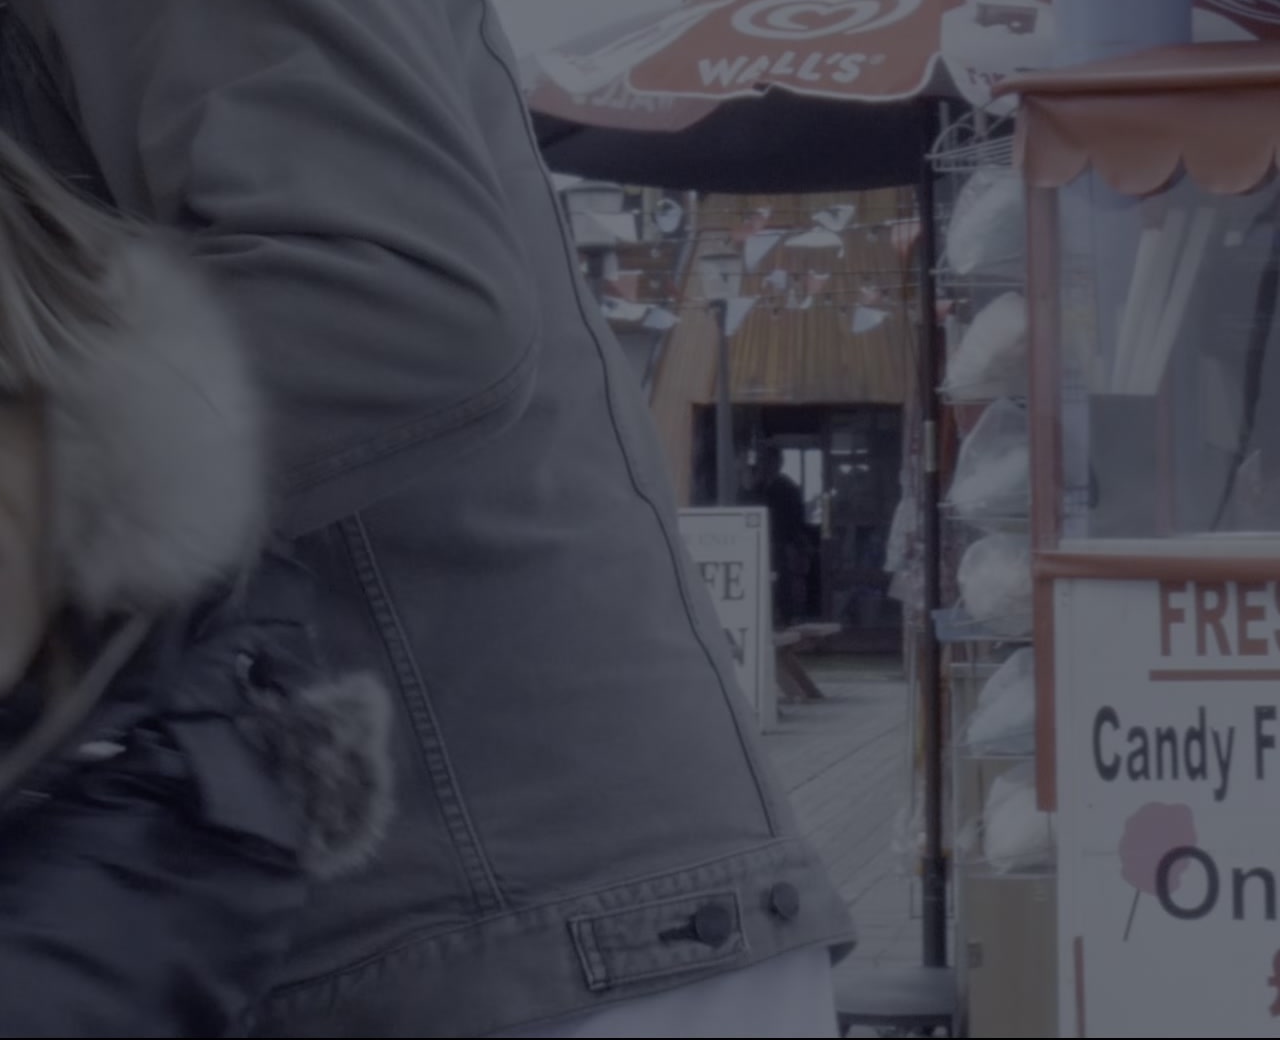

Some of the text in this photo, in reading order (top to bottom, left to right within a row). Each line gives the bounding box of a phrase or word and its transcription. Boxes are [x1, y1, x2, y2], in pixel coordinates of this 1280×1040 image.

[697, 51, 867, 89] WALL'S
[1092, 705, 1236, 802] Candy
[1154, 845, 1278, 922] On
